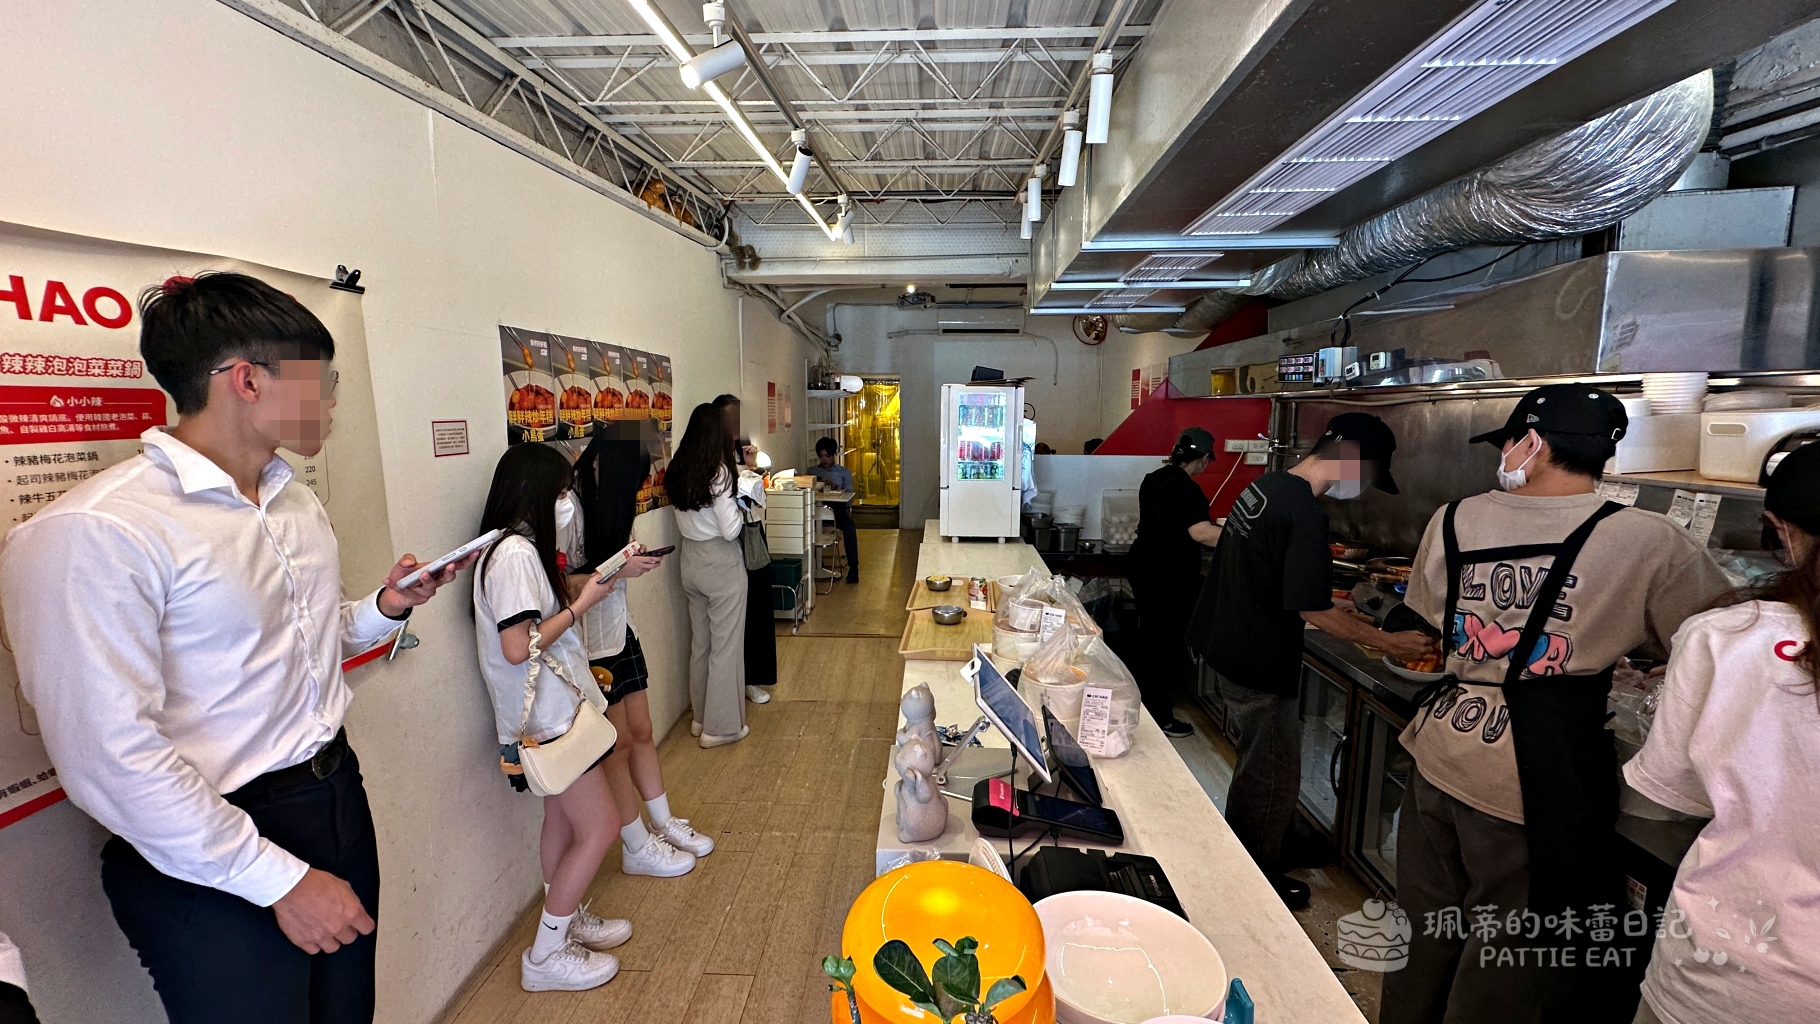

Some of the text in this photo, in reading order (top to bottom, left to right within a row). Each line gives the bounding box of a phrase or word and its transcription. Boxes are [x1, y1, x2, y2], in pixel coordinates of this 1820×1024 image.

[0, 353, 142, 378] 辣辣泡泡菜菜鍋
[67, 396, 102, 407] 小小辣
[13, 451, 99, 467] 辣豬梅花泡菜鍋
[306, 479, 317, 487] 245
